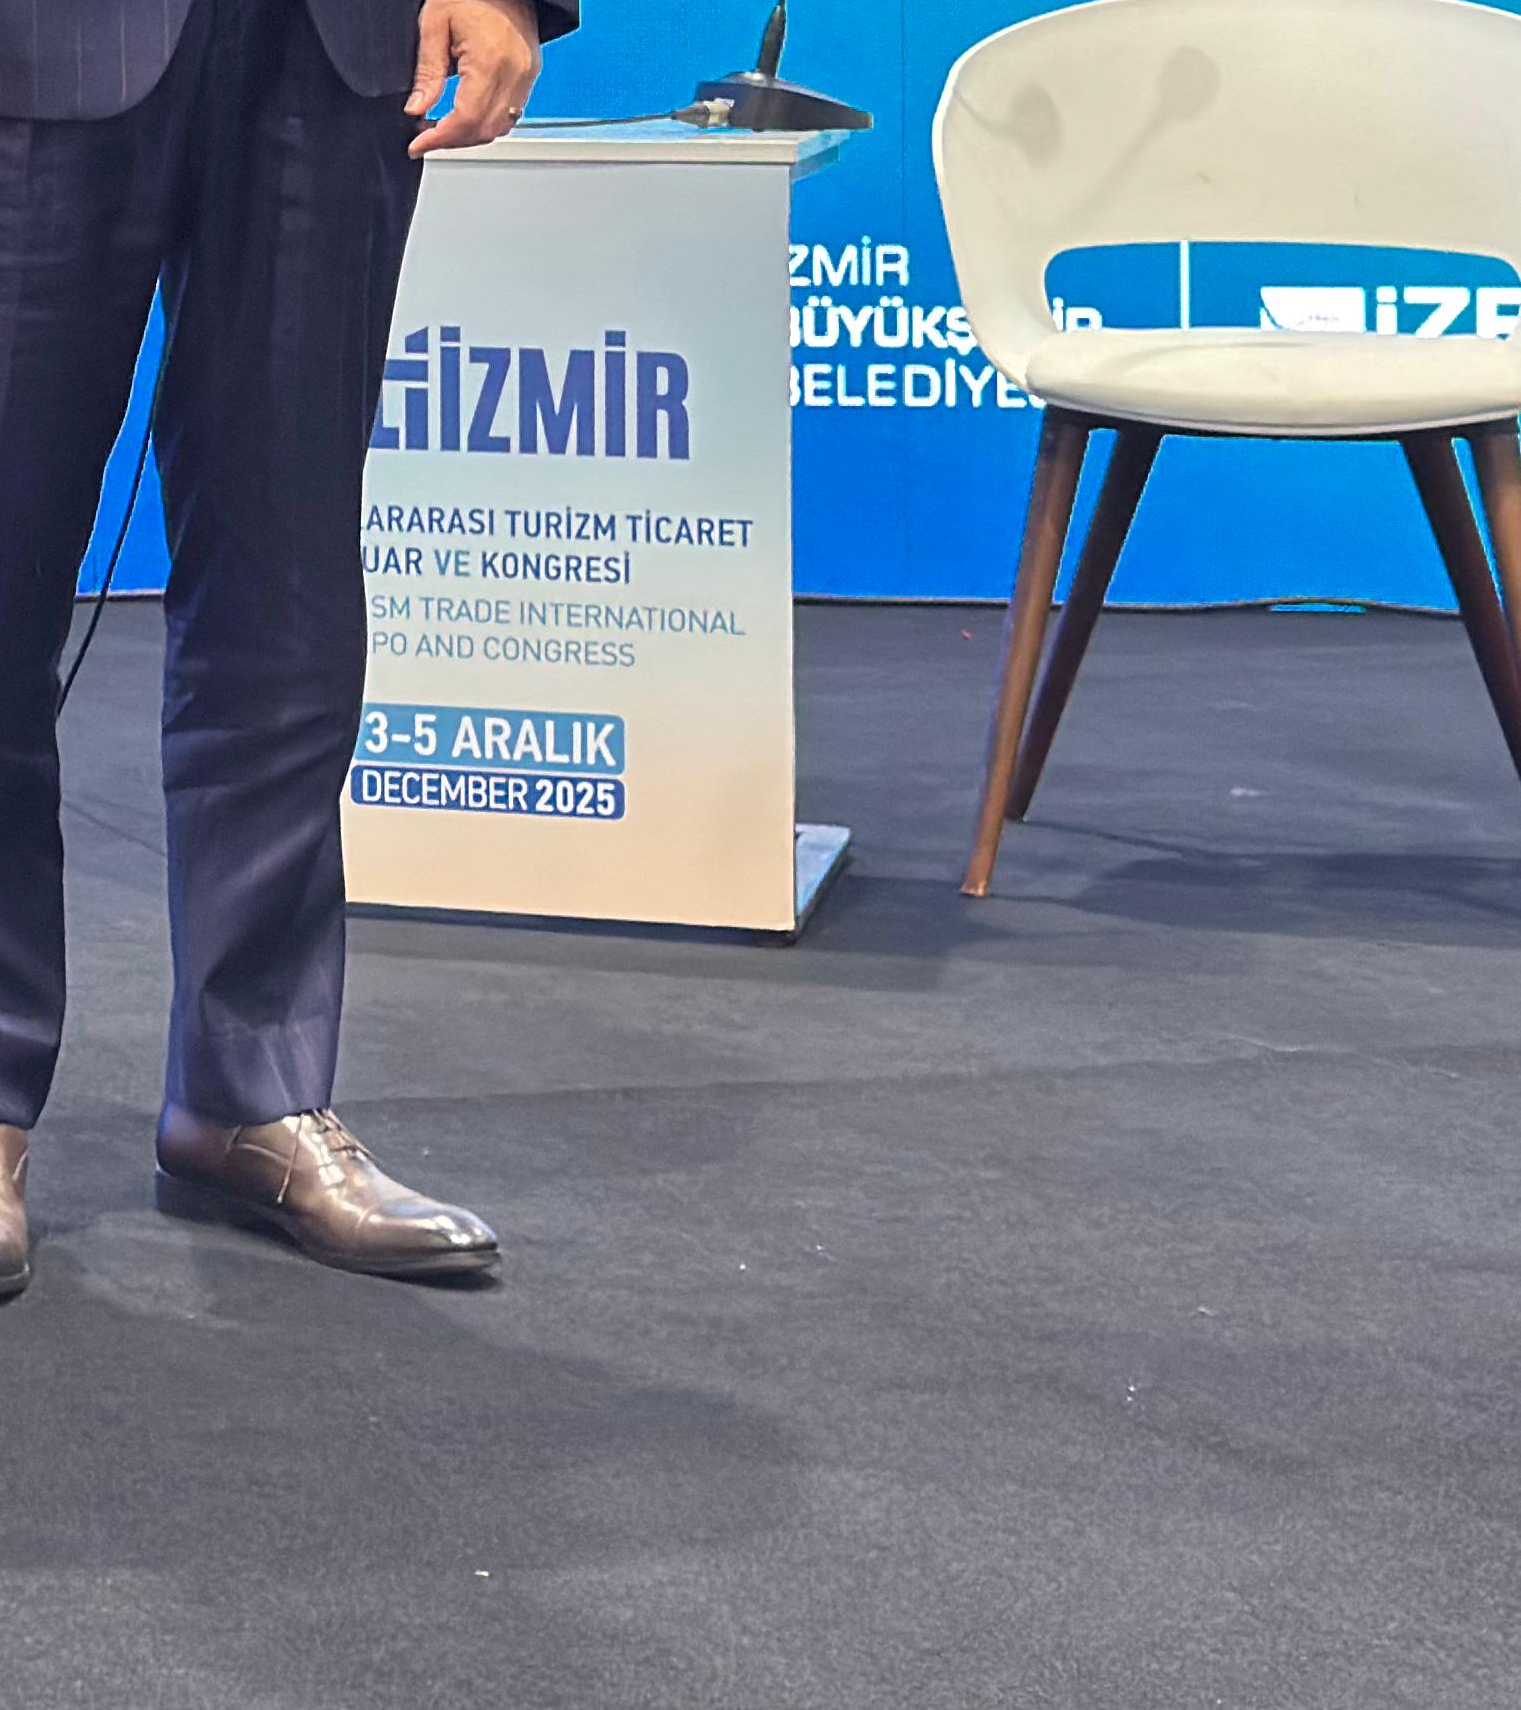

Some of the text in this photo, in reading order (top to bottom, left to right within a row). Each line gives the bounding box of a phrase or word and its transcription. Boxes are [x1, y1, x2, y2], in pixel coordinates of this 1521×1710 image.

[789, 235, 909, 286] ZMİR
[361, 504, 754, 548] ARARASI TURİZM TİCARET
[362, 544, 630, 585] UAR VE KONGRESİ
[418, 596, 512, 625] TRADE
[519, 600, 746, 636] INTERNATIONAL
[414, 632, 475, 660] AND
[482, 635, 636, 668] CONGRESS
[364, 711, 617, 767] 3-5 ARALIK
[361, 769, 616, 816] DECEMBER 2025
